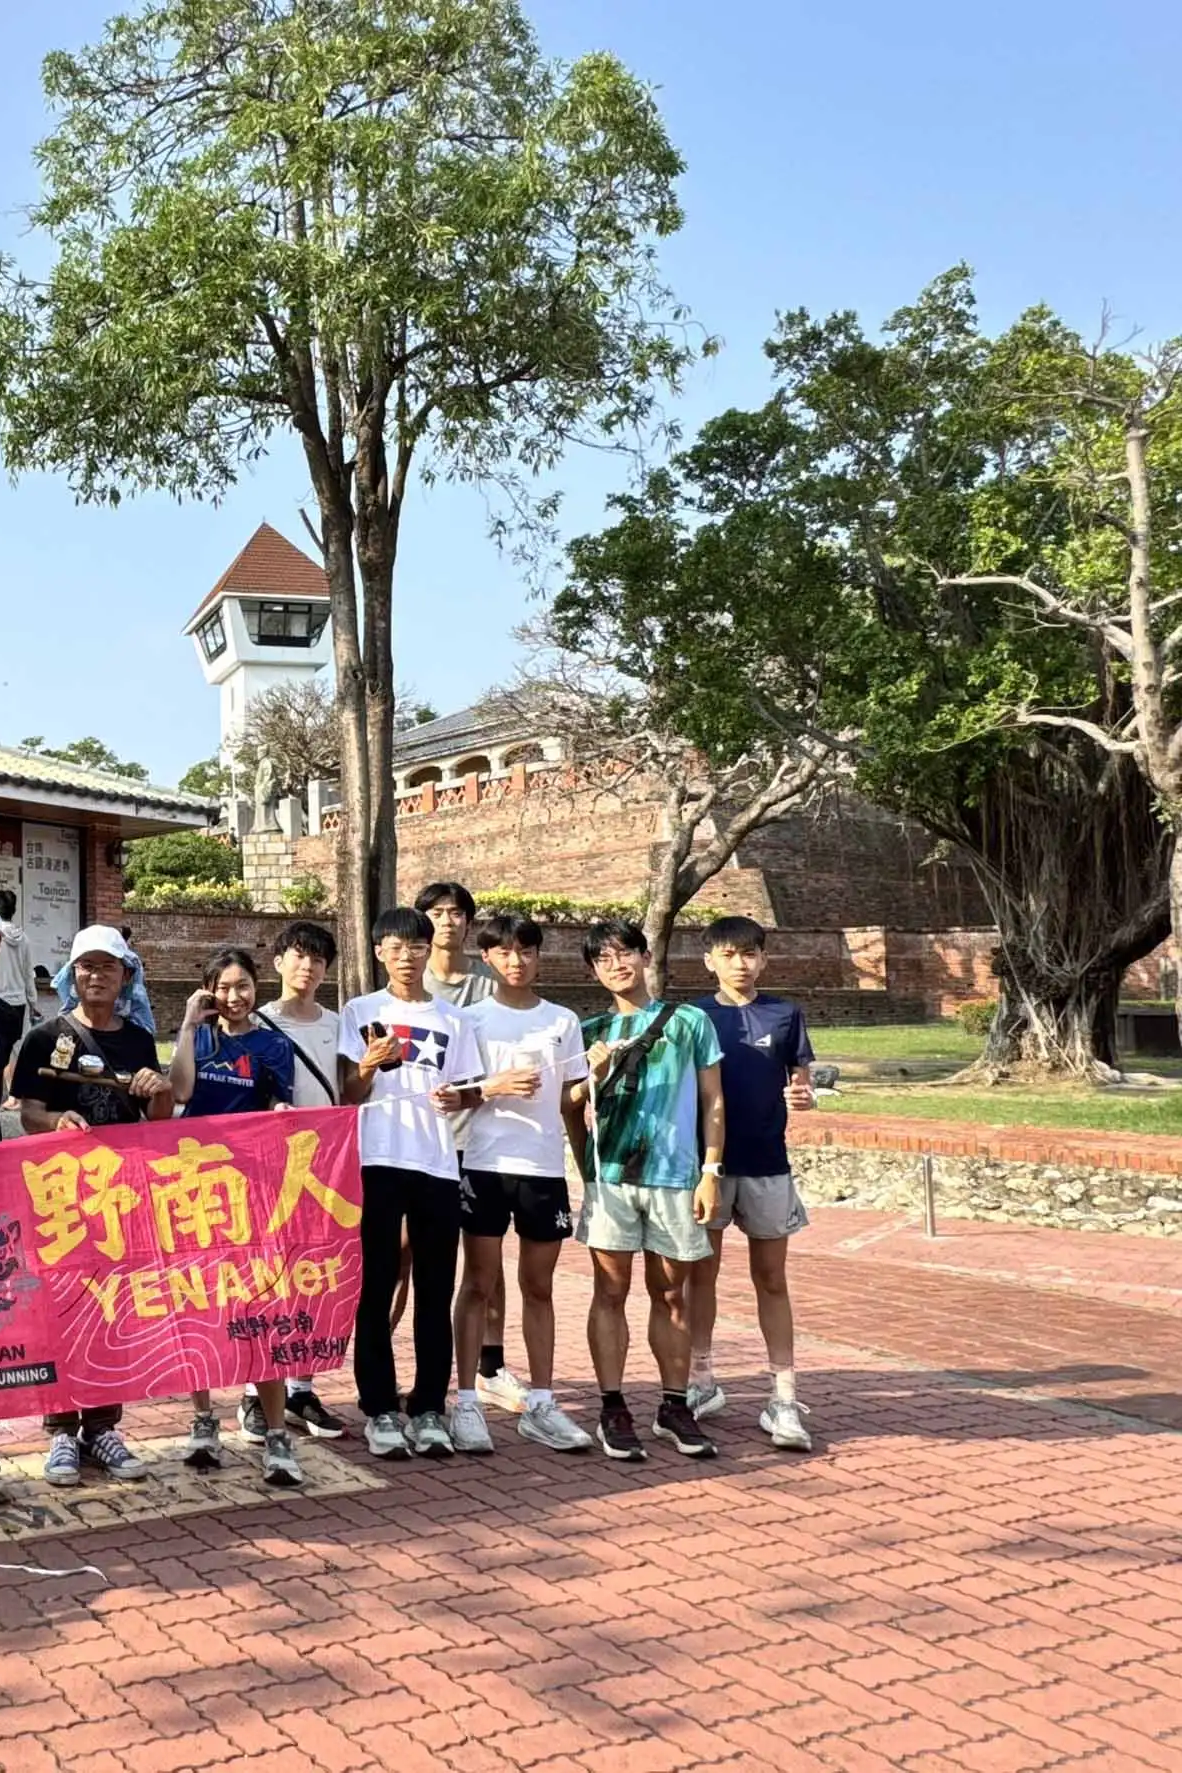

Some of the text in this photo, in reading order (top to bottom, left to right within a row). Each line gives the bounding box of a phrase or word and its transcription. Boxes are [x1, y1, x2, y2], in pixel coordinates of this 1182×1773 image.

[21, 1129, 363, 1265] 野南人
[81, 1255, 343, 1324] YENANer
[227, 1310, 315, 1341] 越野台南
